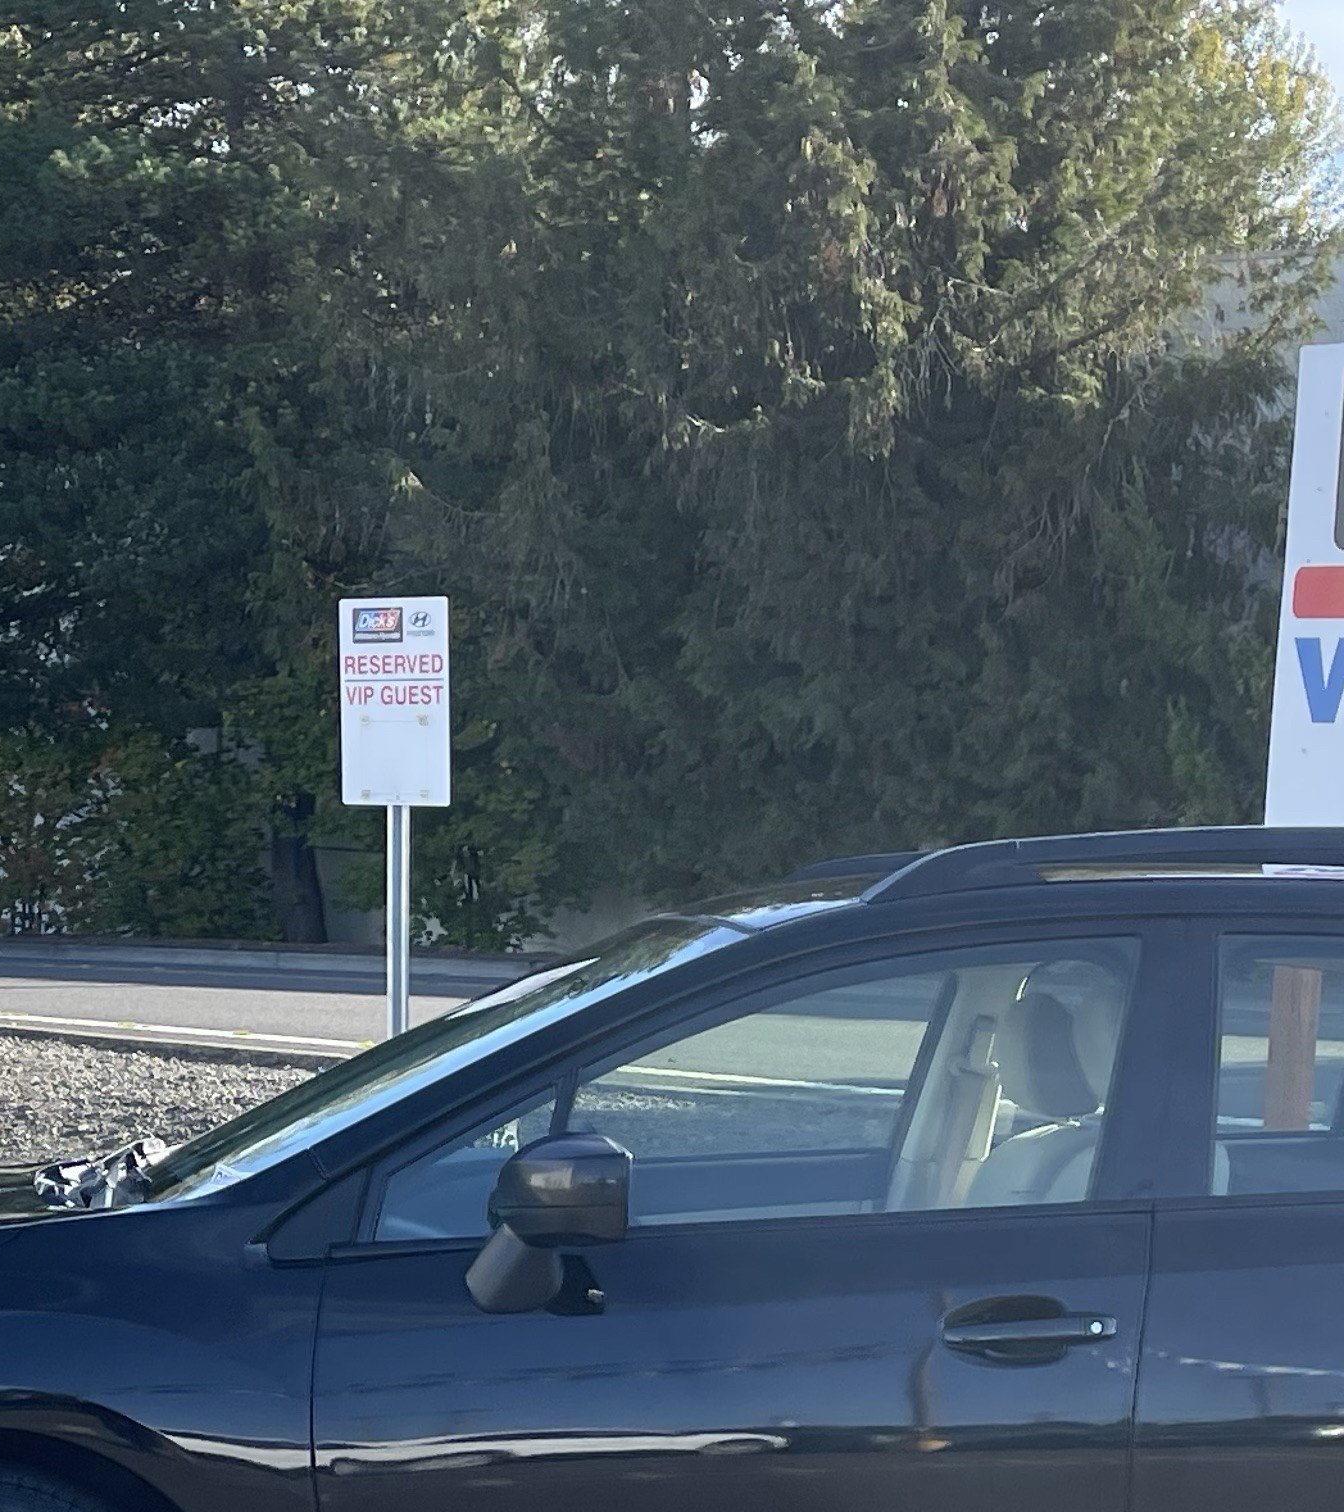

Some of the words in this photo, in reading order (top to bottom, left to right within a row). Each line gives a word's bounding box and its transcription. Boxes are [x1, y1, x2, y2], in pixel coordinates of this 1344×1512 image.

[344, 653, 445, 676] RESERVED
[346, 685, 375, 706] VIP
[380, 684, 445, 706] GUEST
